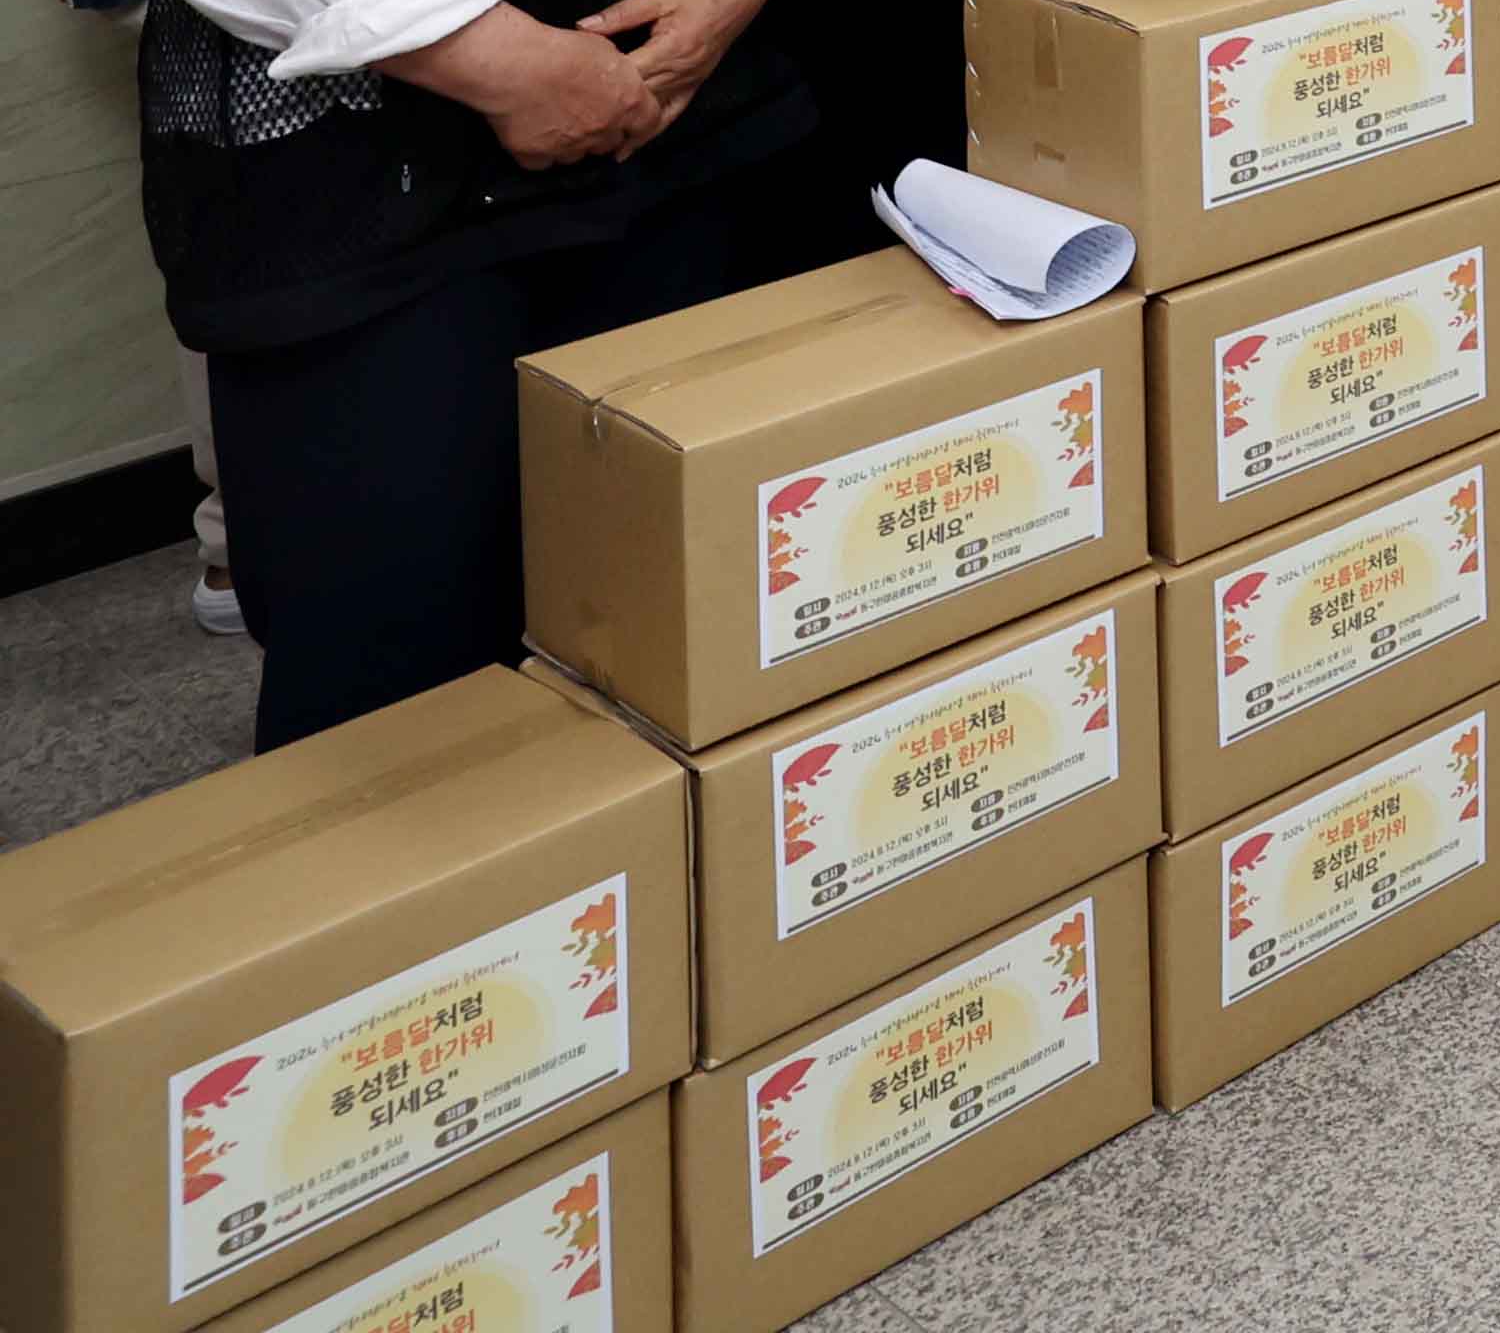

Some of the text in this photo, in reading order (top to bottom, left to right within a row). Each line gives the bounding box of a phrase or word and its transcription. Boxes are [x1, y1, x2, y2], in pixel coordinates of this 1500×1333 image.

[1294, 53, 1390, 100] 풍성한 한가위
[1307, 336, 1403, 391] 풍성한 한가위
[877, 472, 999, 538] 풍성한 한가위
[1307, 564, 1403, 627] 풍성한 한가위
[892, 722, 1015, 799] 풍성한 한가위
[329, 1015, 492, 1119] 풍성한 한가위
[869, 1019, 993, 1106] 풍성한 한가위
